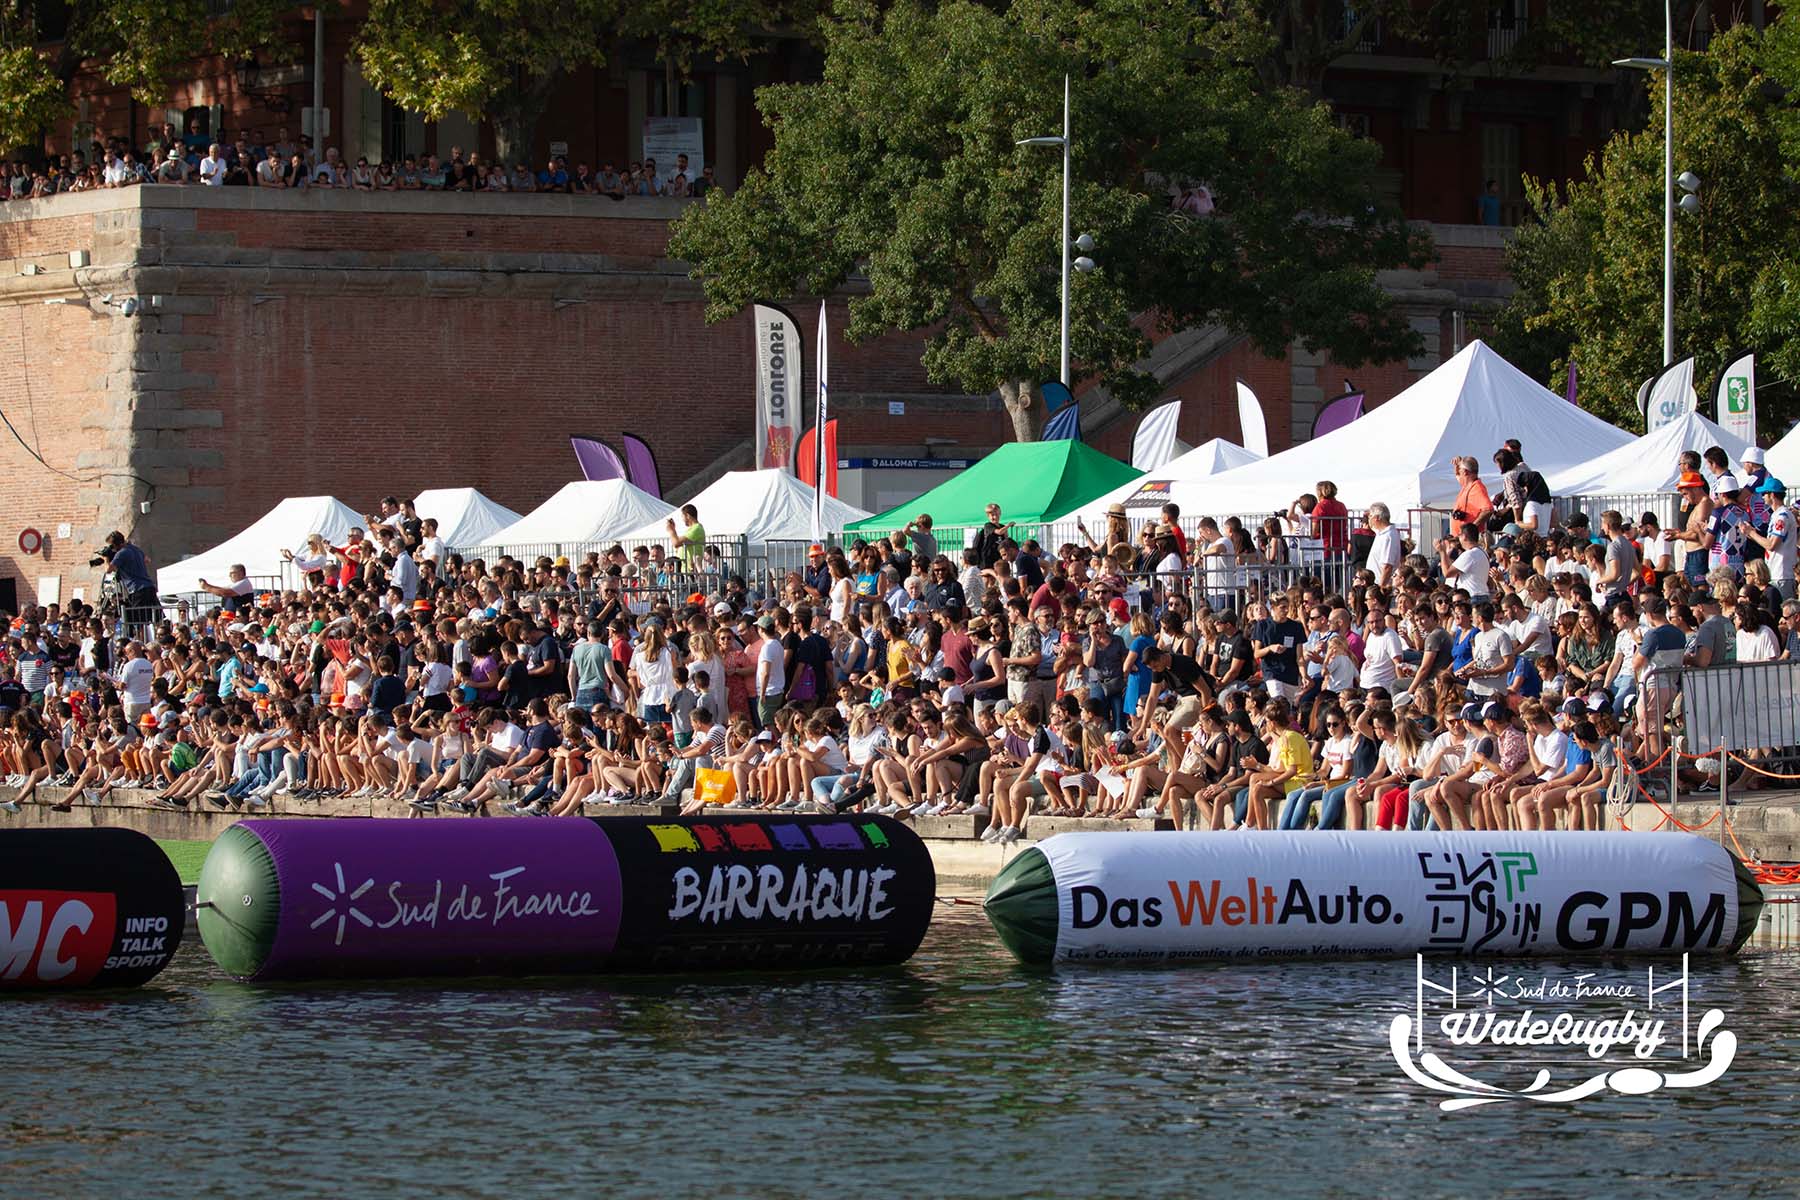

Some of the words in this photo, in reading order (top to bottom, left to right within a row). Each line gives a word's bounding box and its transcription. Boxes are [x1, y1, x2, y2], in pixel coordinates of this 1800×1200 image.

[879, 459, 918, 467] ALLOMAT
[376, 878, 442, 929] Sud
[447, 883, 487, 922] de
[488, 865, 599, 928] France
[668, 863, 897, 926] BARRAQUE
[1073, 885, 1163, 930] Das
[125, 917, 168, 934] INFO
[1556, 890, 1726, 950] GPM
[121, 936, 168, 952] TALK
[1067, 948, 1091, 959] Les
[1094, 948, 1166, 960] Occasions
[1167, 947, 1232, 960] garanties
[1236, 946, 1254, 958] du
[1256, 945, 1308, 959] Groupe
[104, 954, 168, 969] SPORT
